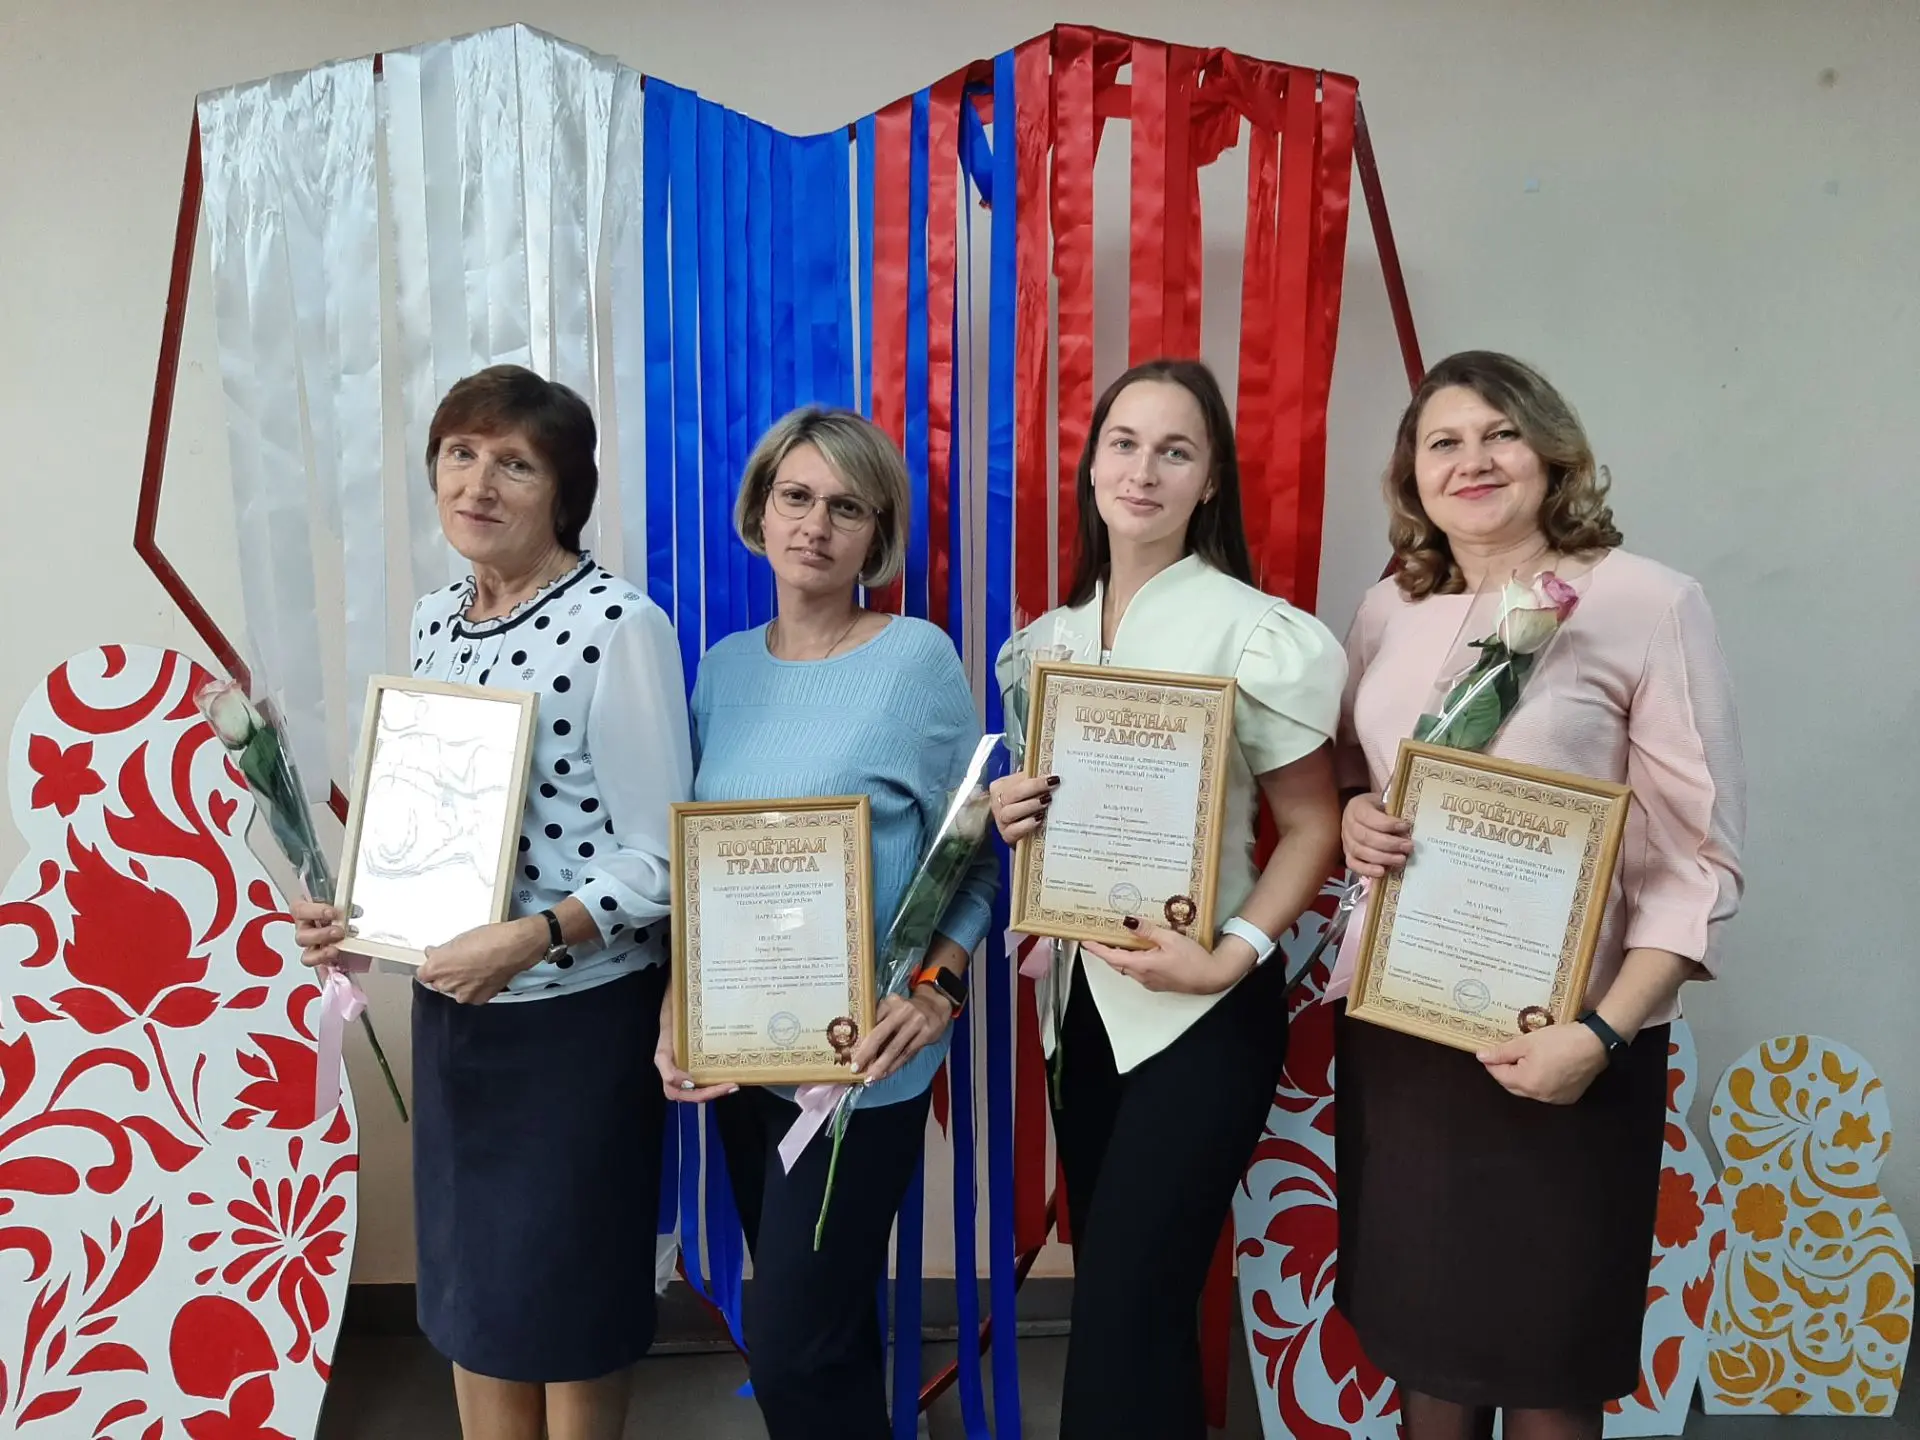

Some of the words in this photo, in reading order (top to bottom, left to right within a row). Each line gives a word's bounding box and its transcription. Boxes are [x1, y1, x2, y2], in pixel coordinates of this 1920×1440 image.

[1075, 706, 1188, 733] ПОЧЁТНАЯ
[1082, 725, 1176, 750] ГРАМОТА
[1440, 792, 1569, 838] ПОЧЁТНАЯ
[717, 836, 827, 857] ПОЧЁТНАЯ
[1445, 813, 1553, 855] ГРАМОТА
[726, 856, 819, 876] ГРАМОТА
